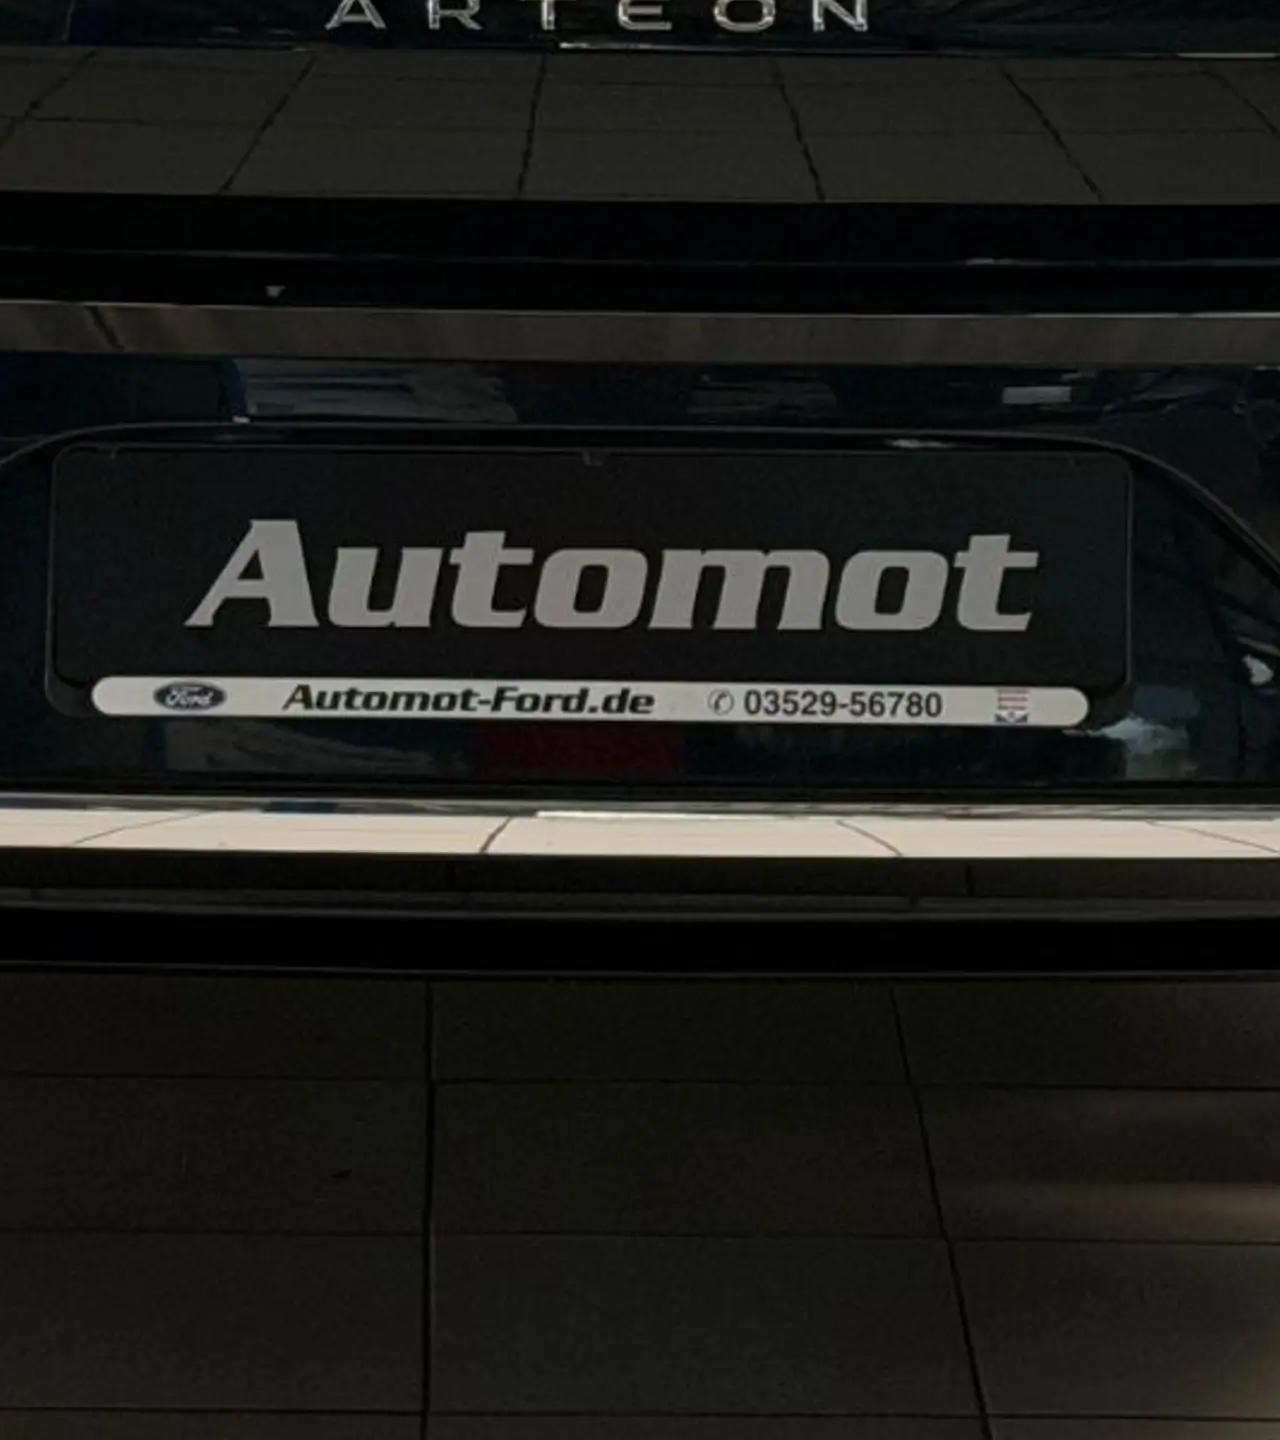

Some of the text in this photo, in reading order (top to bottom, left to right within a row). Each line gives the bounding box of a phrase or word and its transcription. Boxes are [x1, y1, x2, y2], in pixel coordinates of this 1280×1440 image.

[183, 519, 1039, 631] Automot
[162, 684, 943, 718] Ford Automot-Ford.de 03529-56780
